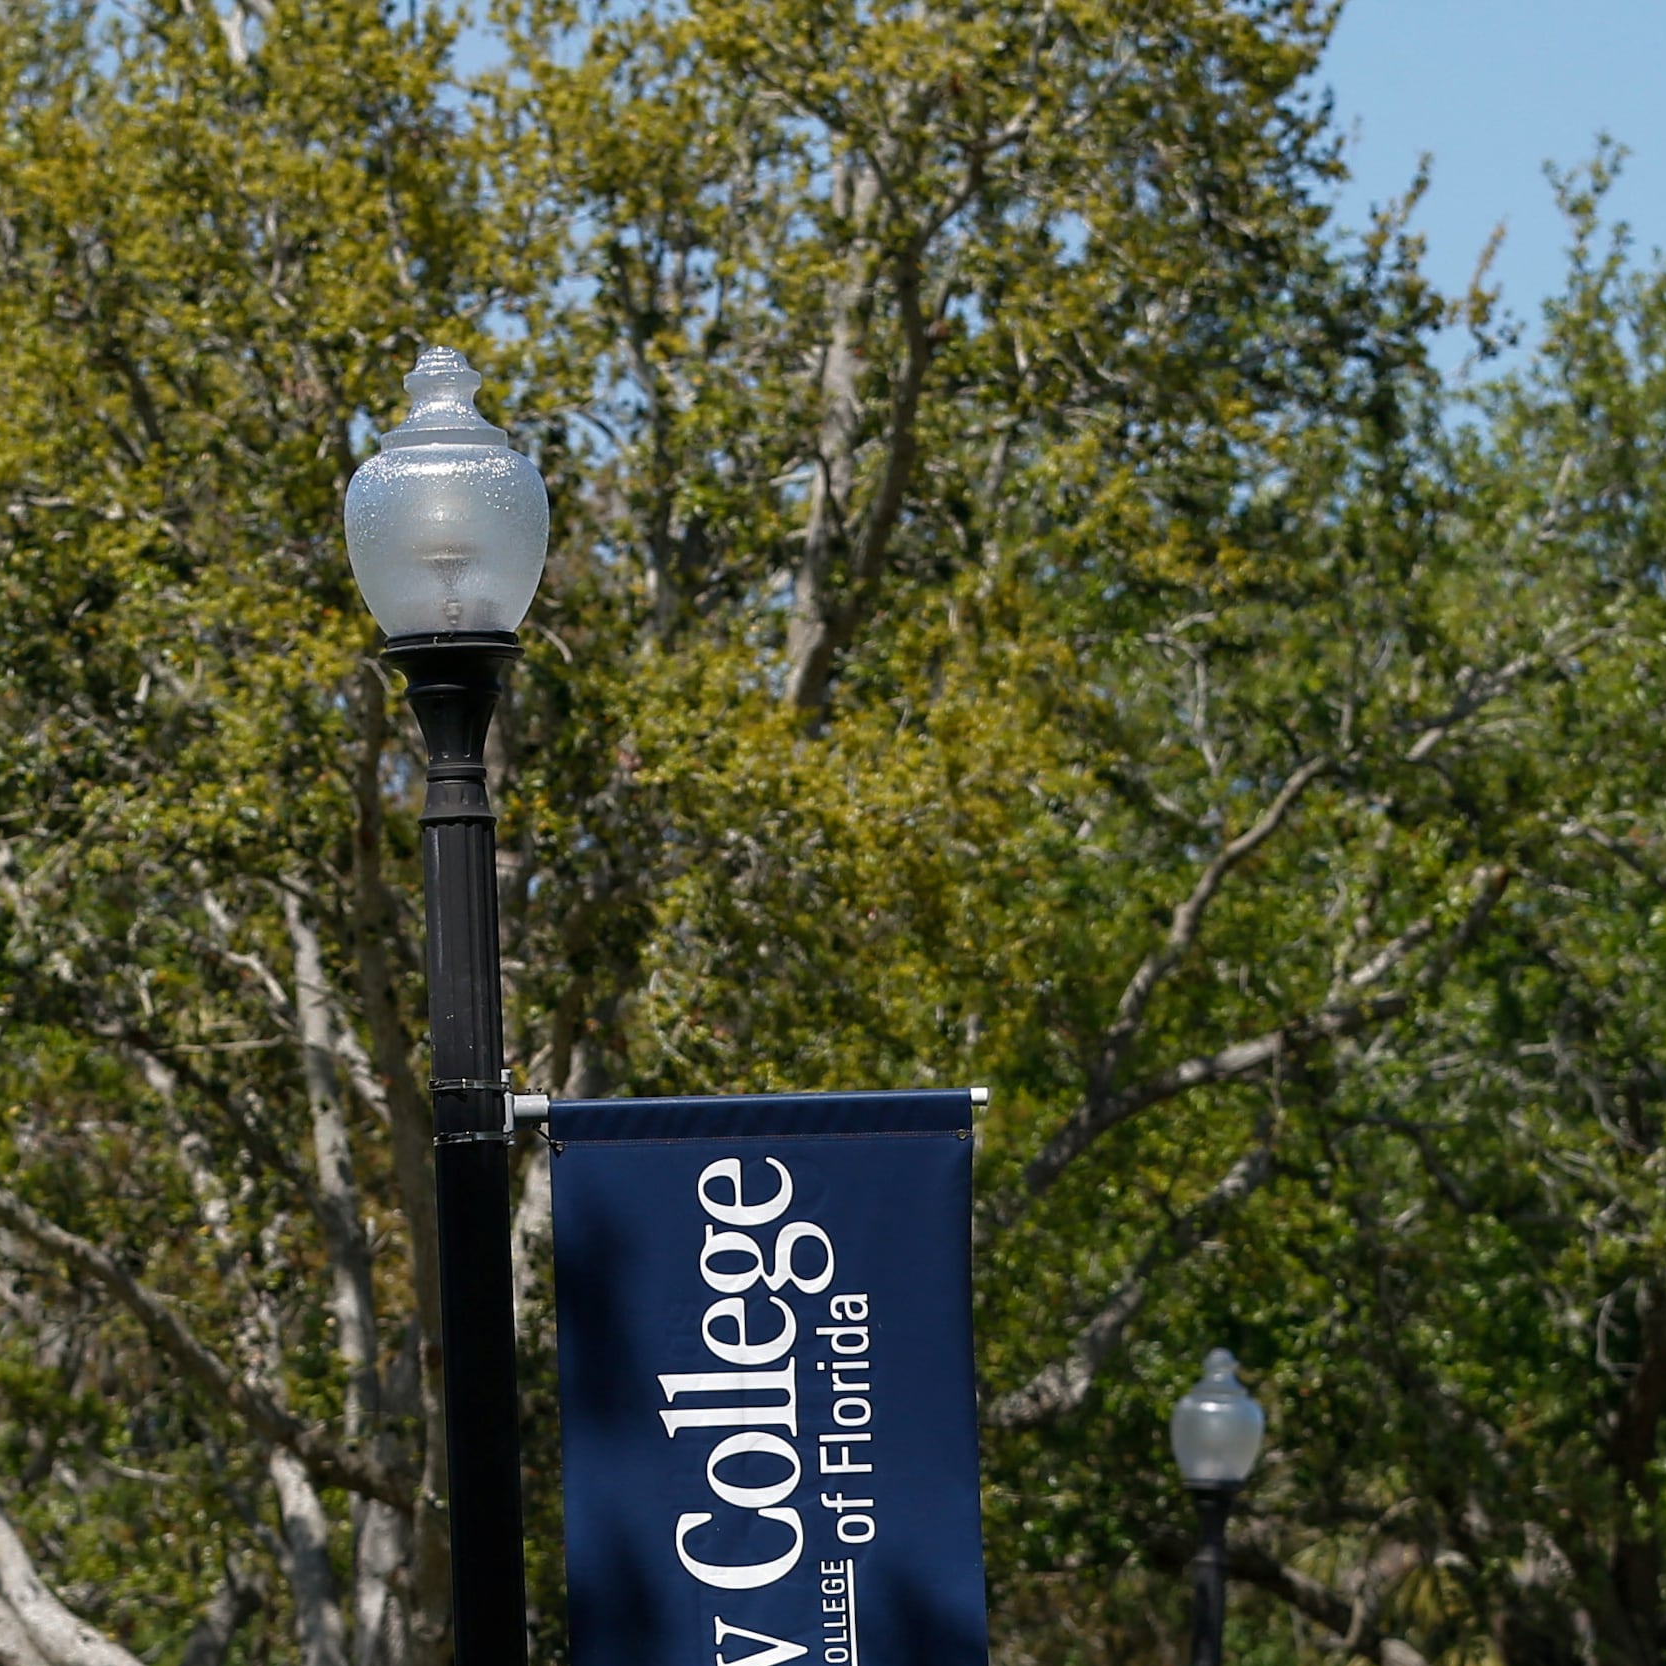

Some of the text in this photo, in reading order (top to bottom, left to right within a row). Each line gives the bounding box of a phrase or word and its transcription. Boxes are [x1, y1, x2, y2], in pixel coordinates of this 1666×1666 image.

[657, 1156, 835, 1590] College
[815, 1293, 876, 1544] of Florida
